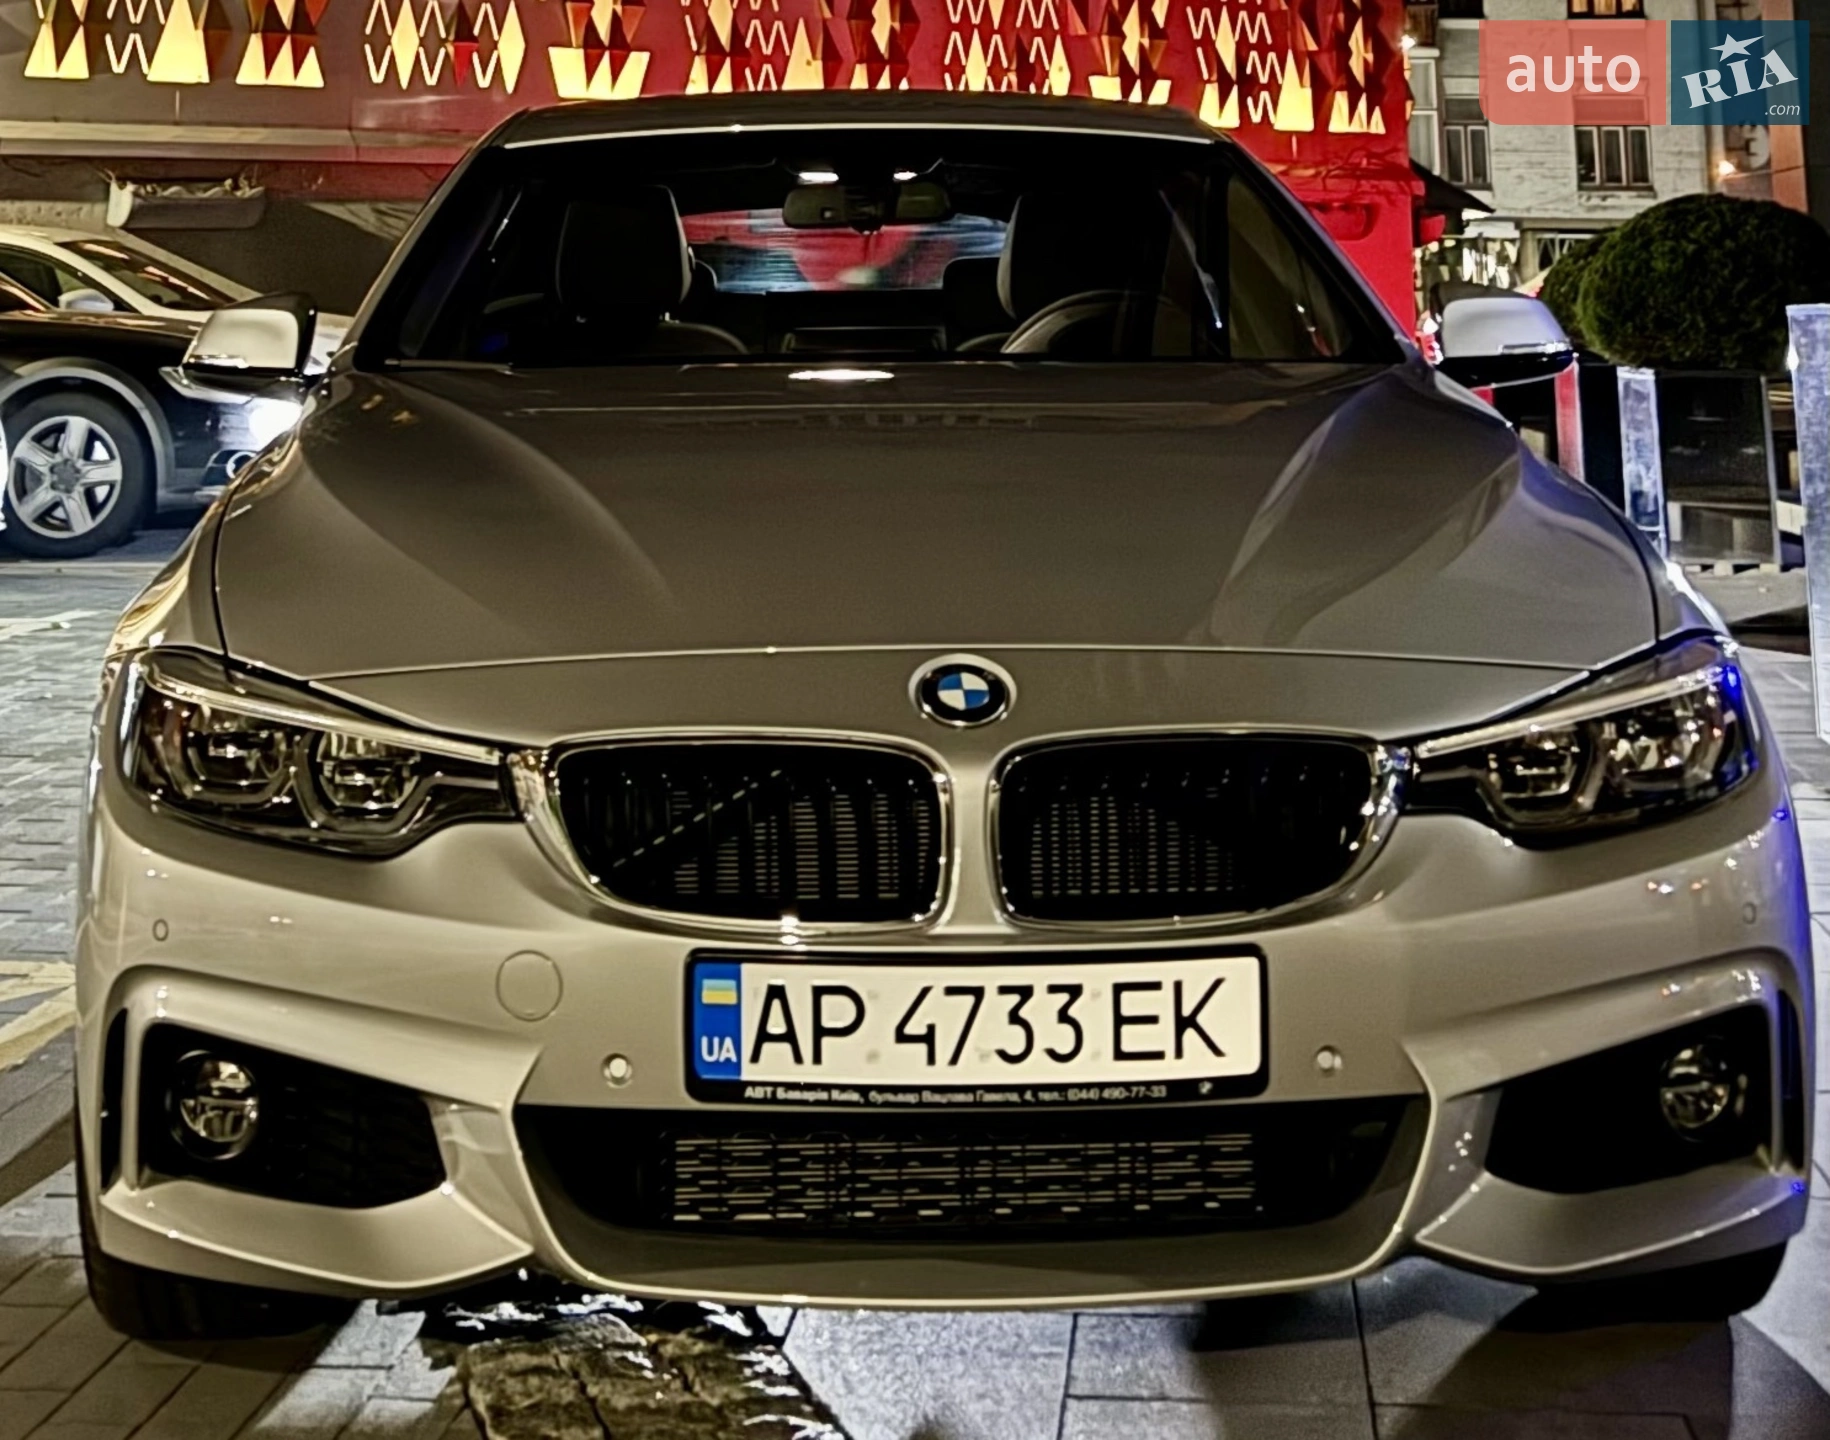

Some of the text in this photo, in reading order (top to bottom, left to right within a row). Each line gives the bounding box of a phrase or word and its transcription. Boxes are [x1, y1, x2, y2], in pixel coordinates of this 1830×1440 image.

[701, 1036, 738, 1063] UA
[750, 977, 1227, 1067] AP 4733 EK
